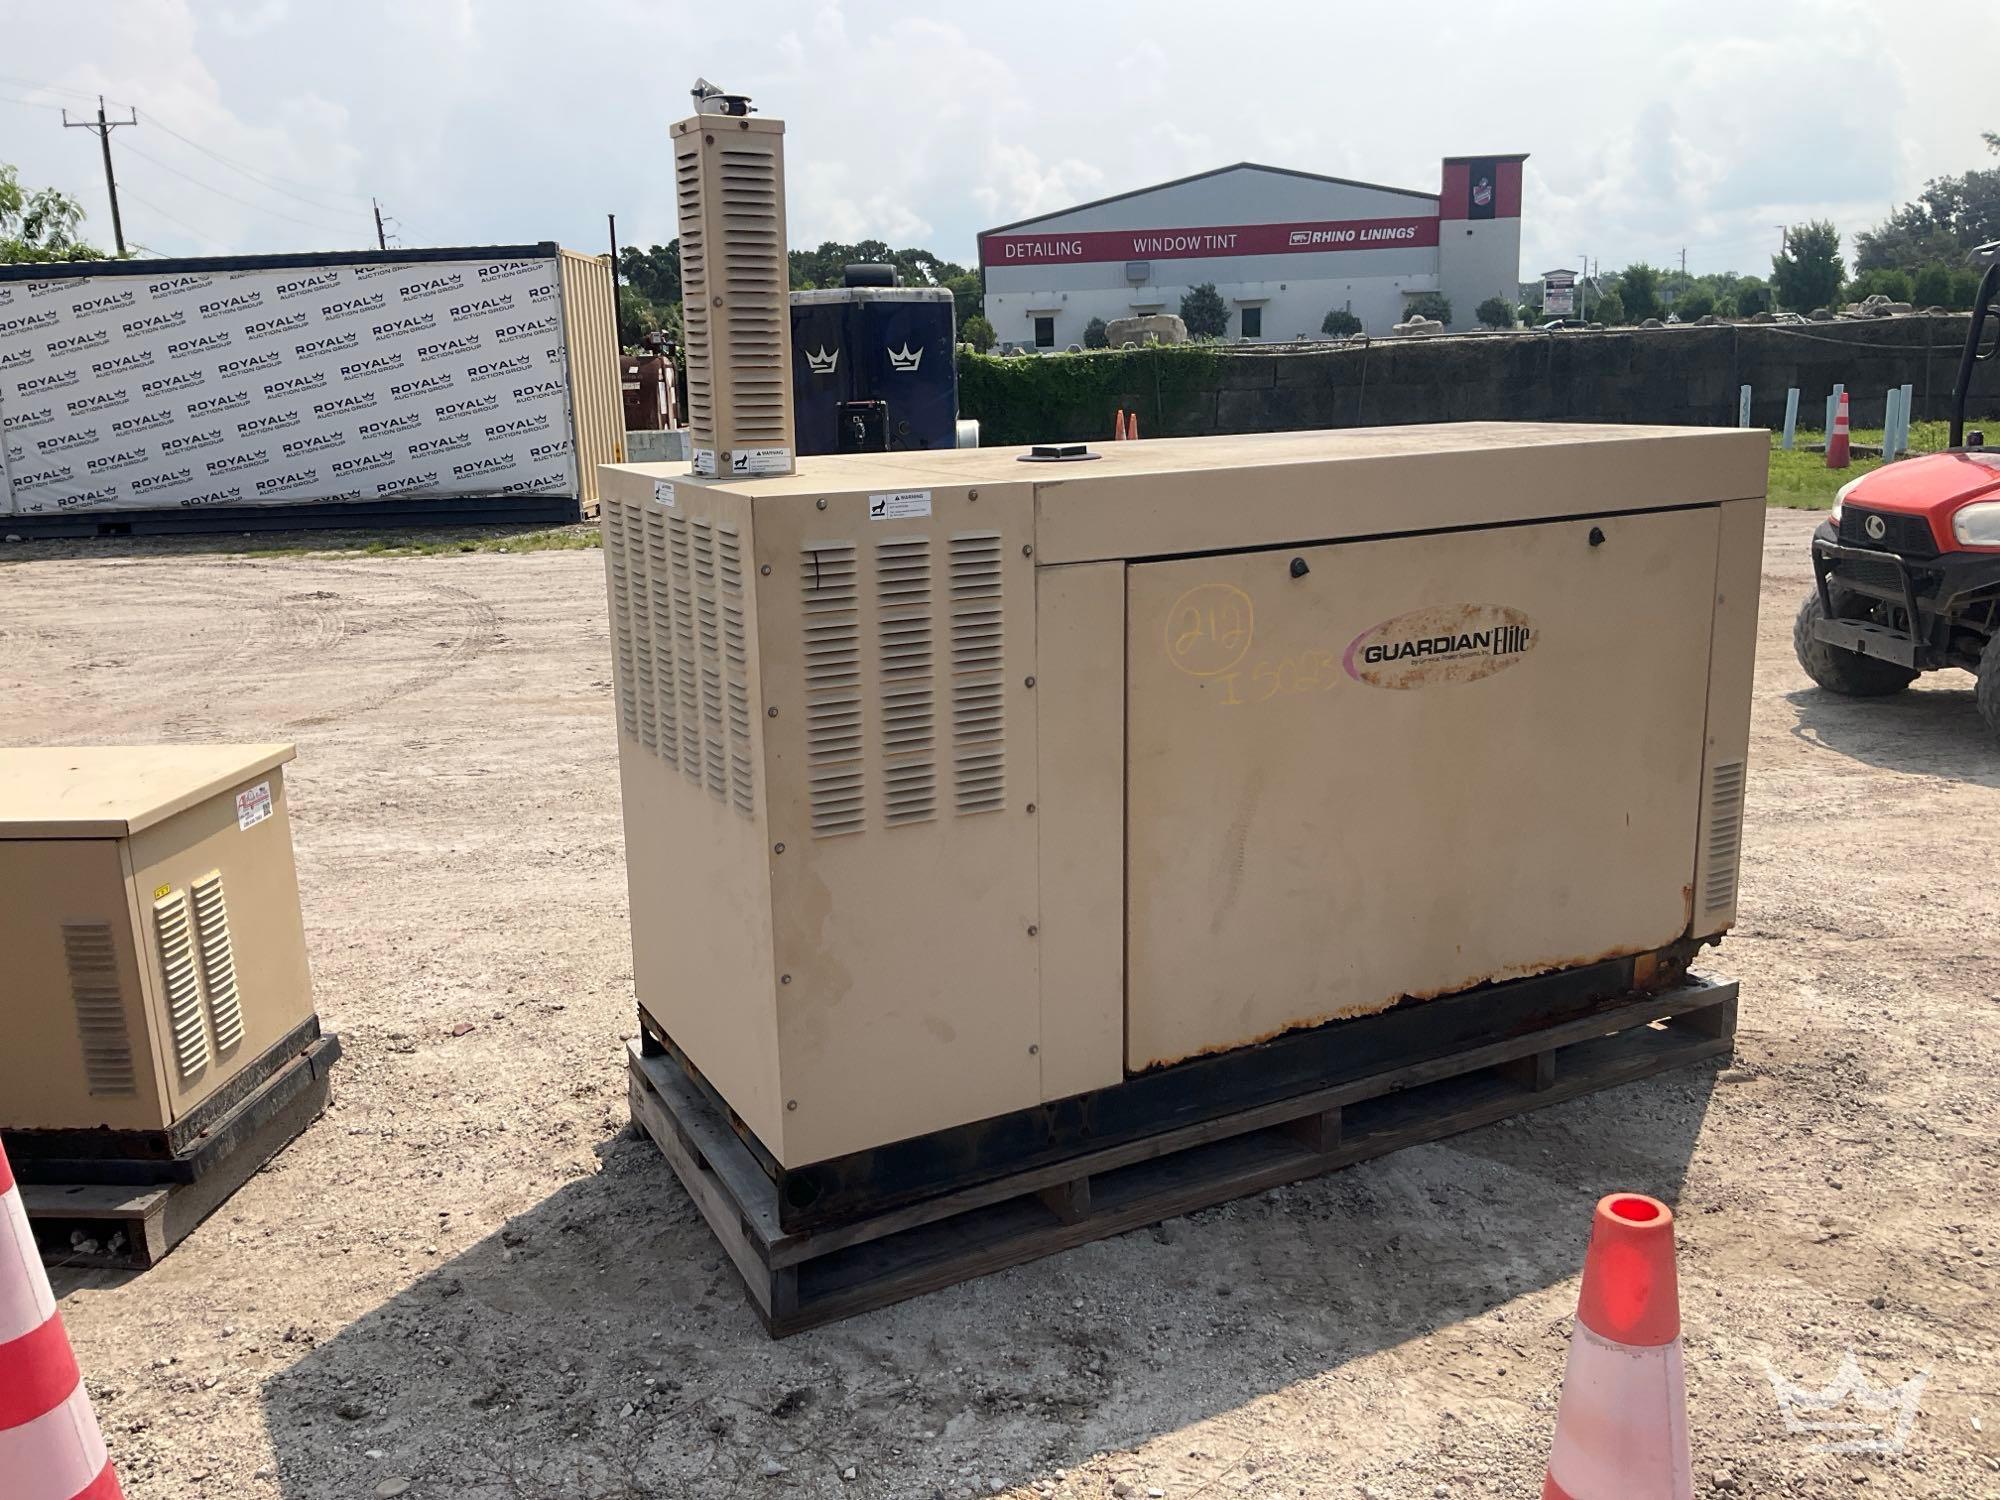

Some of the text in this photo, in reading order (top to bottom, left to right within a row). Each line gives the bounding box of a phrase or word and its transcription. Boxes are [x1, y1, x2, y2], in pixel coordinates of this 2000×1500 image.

[1133, 234, 1237, 253] WINDOW TINT
[1312, 227, 1416, 243] RHINO LININGS
[1005, 240, 1082, 258] DETAILING
[482, 264, 544, 282] AUCTION GROUP
[149, 276, 197, 293] ROYAL
[152, 281, 212, 299] AUCTION GROUP
[276, 277, 325, 294] ROYAL
[280, 282, 340, 299] AUCTION GROUP
[400, 279, 448, 295] ROYAL
[403, 283, 463, 301] AUCTION GROUP
[72, 296, 120, 313] ROYAL
[76, 301, 135, 318] AUCTION GROUP
[199, 296, 248, 313] ROYAL
[203, 301, 262, 318] AUCTION GROUP
[322, 298, 370, 315] ROYAL
[325, 303, 385, 320] AUCTION GROUP
[450, 299, 498, 316] ROYAL
[454, 304, 513, 321] AUCTION GROUP
[34, 320, 60, 330] GROUP
[122, 316, 170, 332] ROYAL
[126, 320, 185, 338] AUCTION GROUP
[245, 318, 294, 334] ROYAL
[249, 322, 308, 340] AUCTION GROUP
[372, 318, 420, 334] ROYAL
[376, 322, 435, 340] AUCTION GROUP
[496, 320, 544, 337] ROYAL
[46, 335, 95, 352] ROYAL
[168, 337, 216, 353] ROYAL
[296, 338, 344, 354] ROYAL
[499, 332, 531, 343] AUCTION
[50, 340, 109, 357] AUCTION GROUP
[171, 341, 231, 359] AUCTION GROUP
[299, 342, 359, 360] AUCTION GROUP
[418, 340, 466, 356] ROYAL
[422, 344, 481, 362] AUCTION GROUP
[92, 356, 140, 372] ROYAL
[95, 360, 155, 378] AUCTION GROUP
[218, 356, 267, 373] ROYAL
[222, 361, 282, 379] AUCTION GROUP
[341, 359, 390, 375] ROYAL
[345, 363, 404, 381] AUCTION GROUP
[468, 360, 516, 376] ROYAL
[471, 364, 531, 382] AUCTION GROUP
[16, 375, 65, 391] ROYAL
[20, 379, 80, 397] AUCTION GROUP
[142, 376, 190, 392] ROYAL
[146, 380, 205, 398] AUCTION GROUP
[264, 378, 312, 394] ROYAL
[268, 382, 327, 400] AUCTION GROUP
[391, 378, 439, 395] ROYAL
[513, 381, 562, 397] ROYAL
[394, 383, 454, 401] AUCTION GROUP
[517, 392, 549, 403] AUCTION
[66, 394, 115, 411] ROYAL
[70, 399, 129, 416] AUCTION GROUP
[187, 396, 236, 413] ROYAL
[191, 401, 250, 418] AUCTION GROUP
[314, 397, 362, 414] ROYAL
[318, 402, 377, 419] AUCTION GROUP
[436, 400, 484, 416] ROYAL
[439, 404, 499, 422] AUCTION GROUP
[111, 415, 160, 432] ROYAL
[115, 420, 174, 437] AUCTION GROUP
[237, 416, 286, 432] ROYAL
[241, 420, 300, 438] AUCTION GROUP
[359, 417, 408, 434] ROYAL
[363, 422, 422, 439] AUCTION GROUP
[485, 419, 533, 436] ROYAL
[38, 432, 86, 449] ROYAL
[488, 424, 548, 441] AUCTION GROUP
[41, 437, 101, 455] AUCTION GROUP
[161, 434, 209, 451] ROYAL
[164, 439, 224, 456] AUCTION GROUP
[282, 436, 330, 453] ROYAL
[286, 441, 345, 458] AUCTION GROUP
[408, 437, 457, 453] ROYAL
[412, 441, 471, 459] AUCTION GROUP
[86, 452, 135, 469] ROYAL
[90, 457, 149, 475] AUCTION GROUP
[206, 454, 255, 471] ROYAL
[210, 459, 269, 477] AUCTION GROUP
[332, 455, 380, 471] ROYAL
[336, 459, 395, 477] AUCTION GROUP
[453, 458, 502, 474] ROYAL
[13, 470, 62, 486] ROYAL
[457, 462, 516, 480] AUCTION GROUP
[130, 473, 179, 489] ROYAL
[134, 477, 194, 495] AUCTION GROUP
[256, 474, 304, 490] ROYAL
[260, 478, 319, 496] AUCTION GROUP
[376, 476, 425, 492] ROYAL
[414, 480, 440, 490] GROUP
[540, 482, 567, 492] GROUP
[57, 490, 106, 506] ROYAL
[1365, 625, 1530, 664] GUARDIAN Elite
